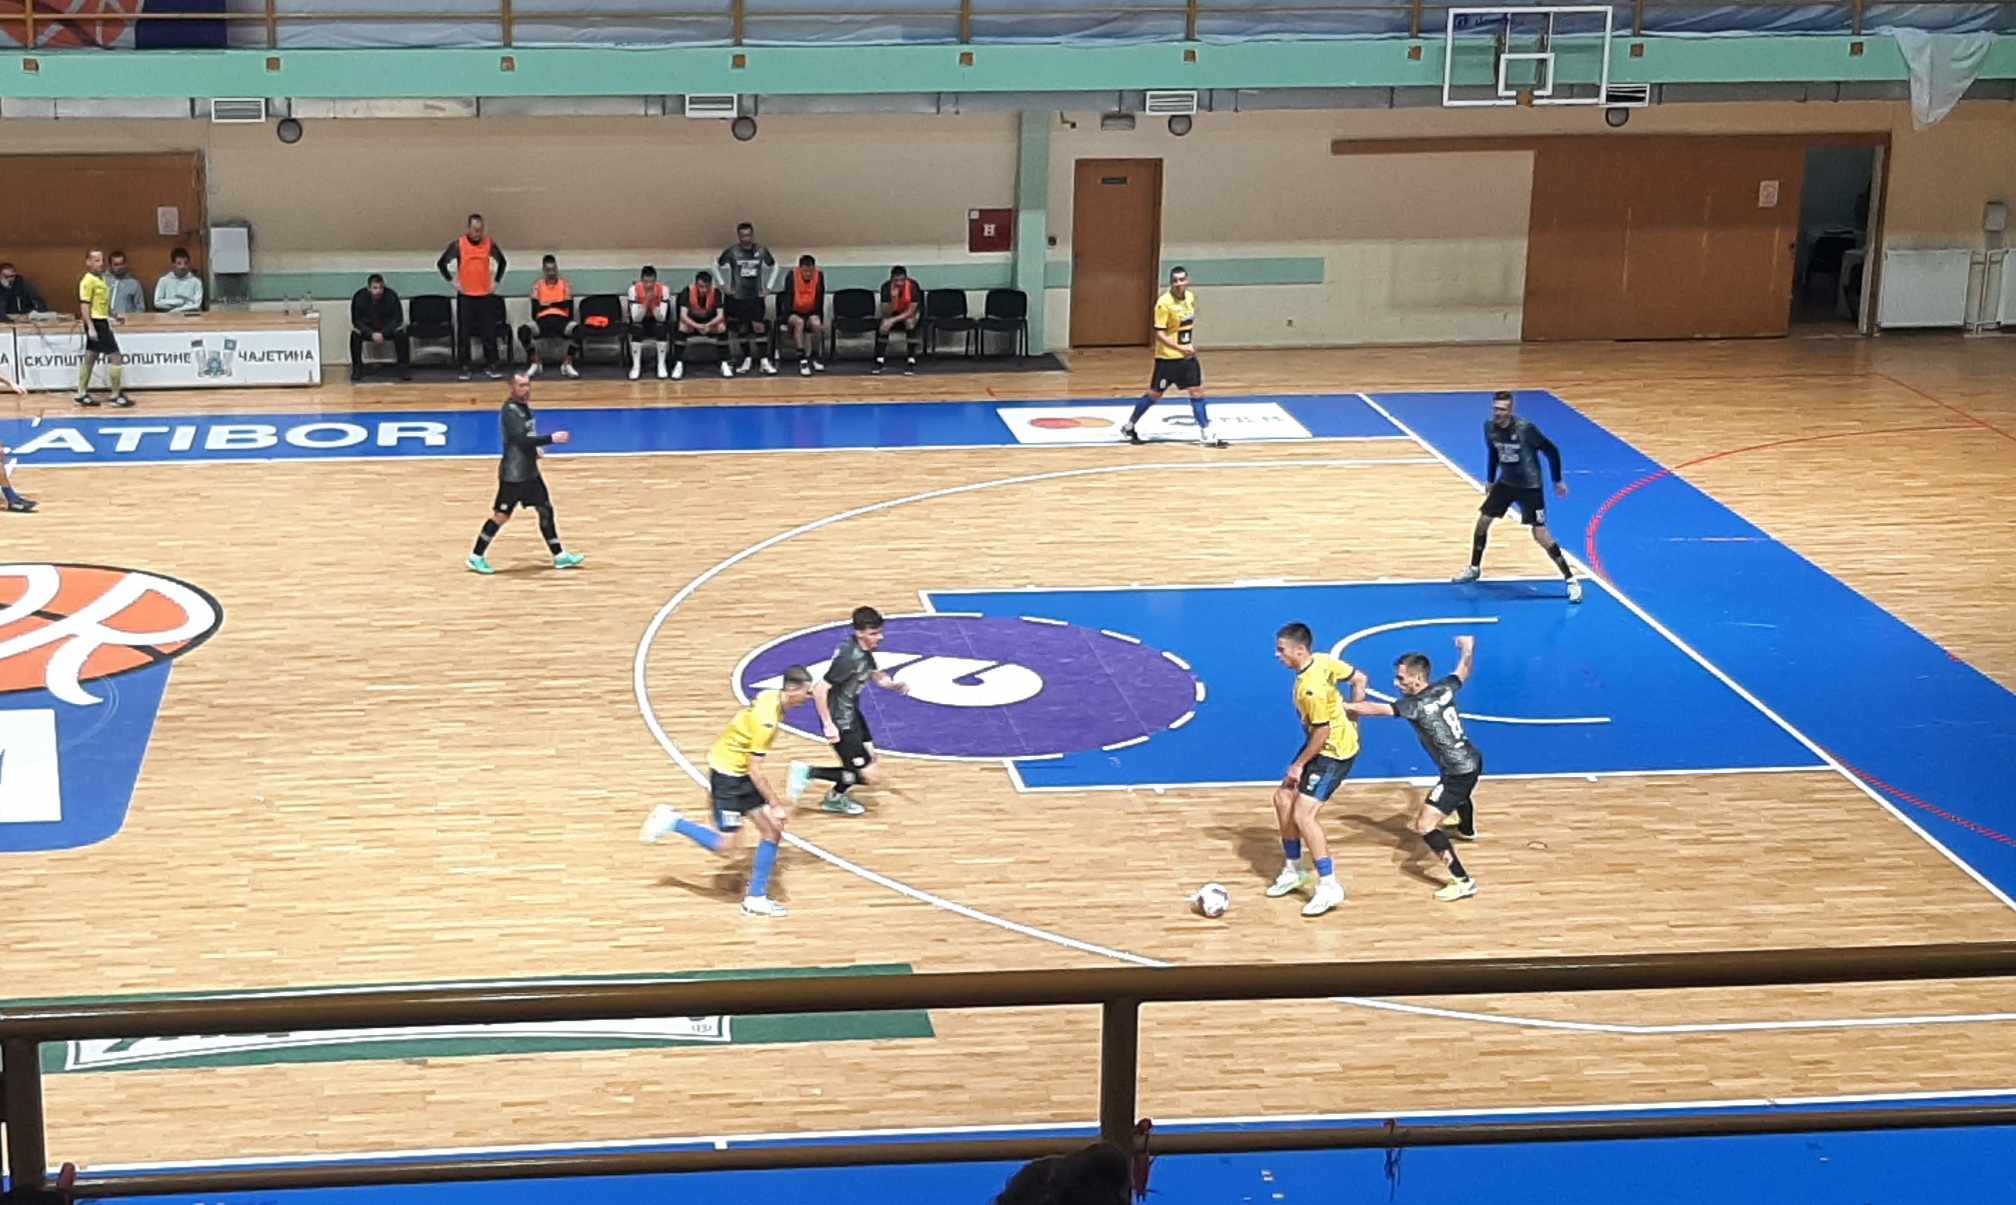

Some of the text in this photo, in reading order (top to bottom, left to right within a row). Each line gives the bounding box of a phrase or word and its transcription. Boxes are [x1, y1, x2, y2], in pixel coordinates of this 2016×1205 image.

[24, 349, 314, 367] СКУПШТН ОПШТИНЕ ЧАЈЕТИНА
[3, 420, 449, 454] ATIBOR
